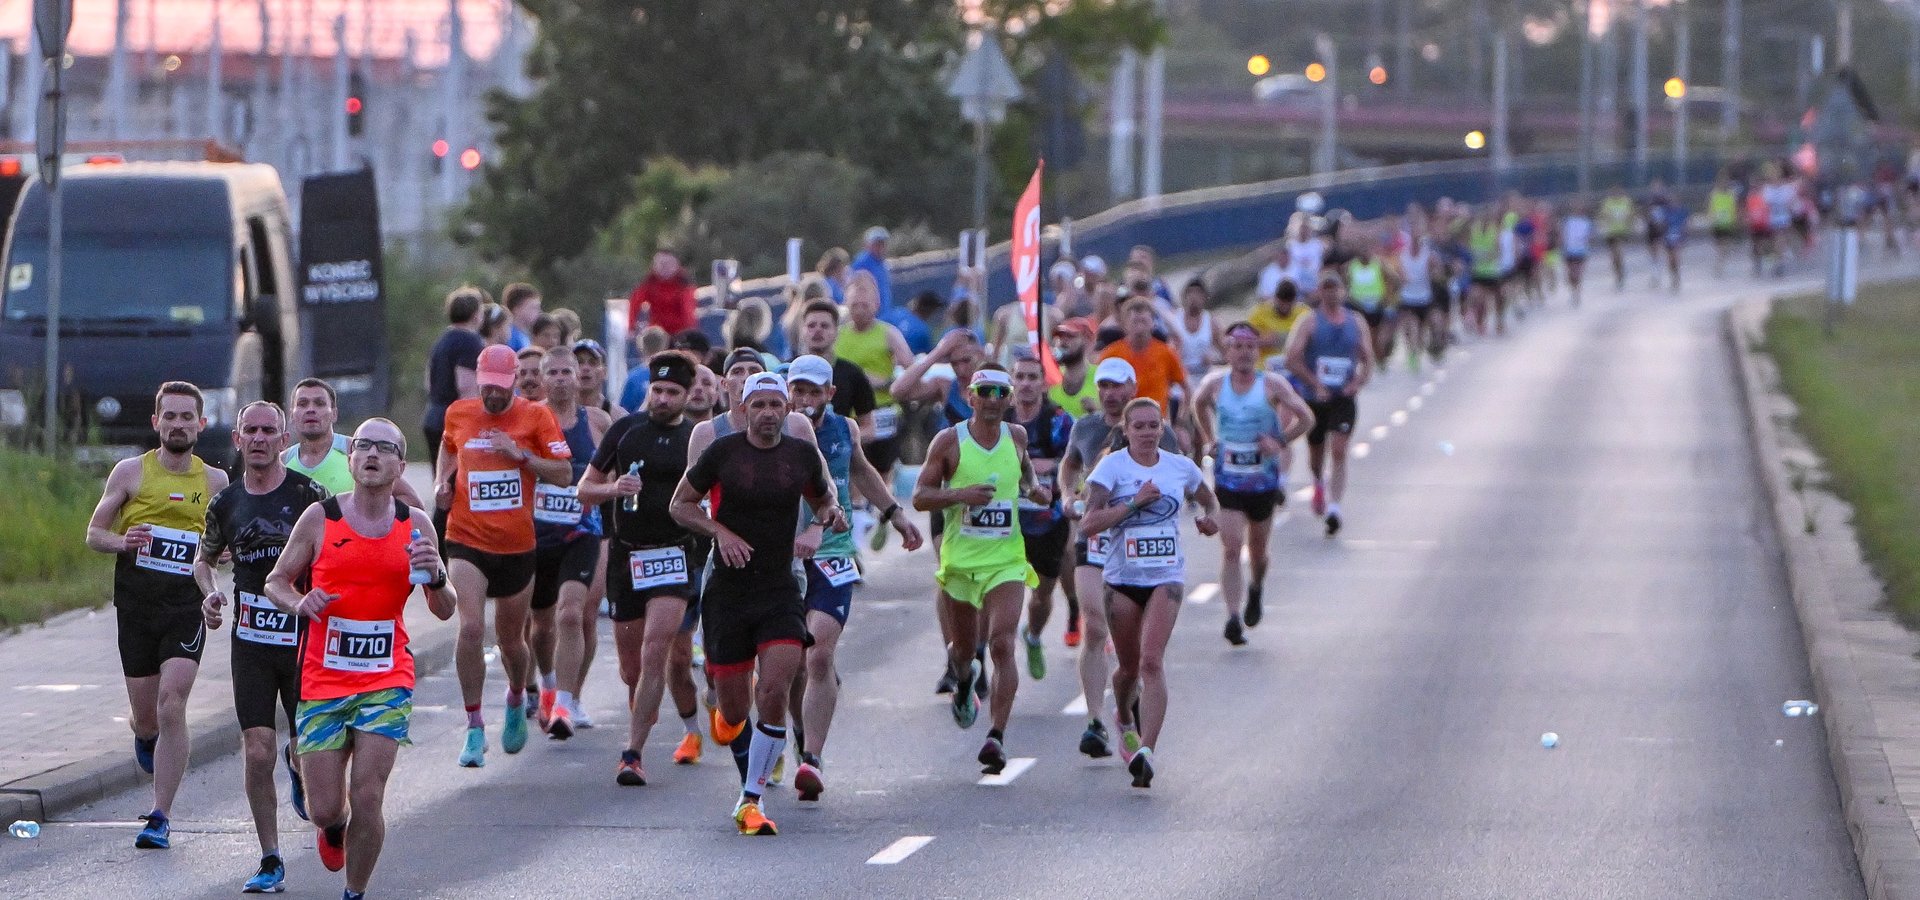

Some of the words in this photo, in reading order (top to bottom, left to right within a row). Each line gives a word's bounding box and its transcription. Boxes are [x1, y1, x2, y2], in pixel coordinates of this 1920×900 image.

[480, 481, 519, 499] 3620
[980, 511, 1006, 526] 419
[161, 541, 188, 560] 712
[1138, 540, 1175, 555] 3359
[643, 558, 684, 576] 3958
[255, 611, 289, 629] 647
[347, 636, 387, 656] 1710
